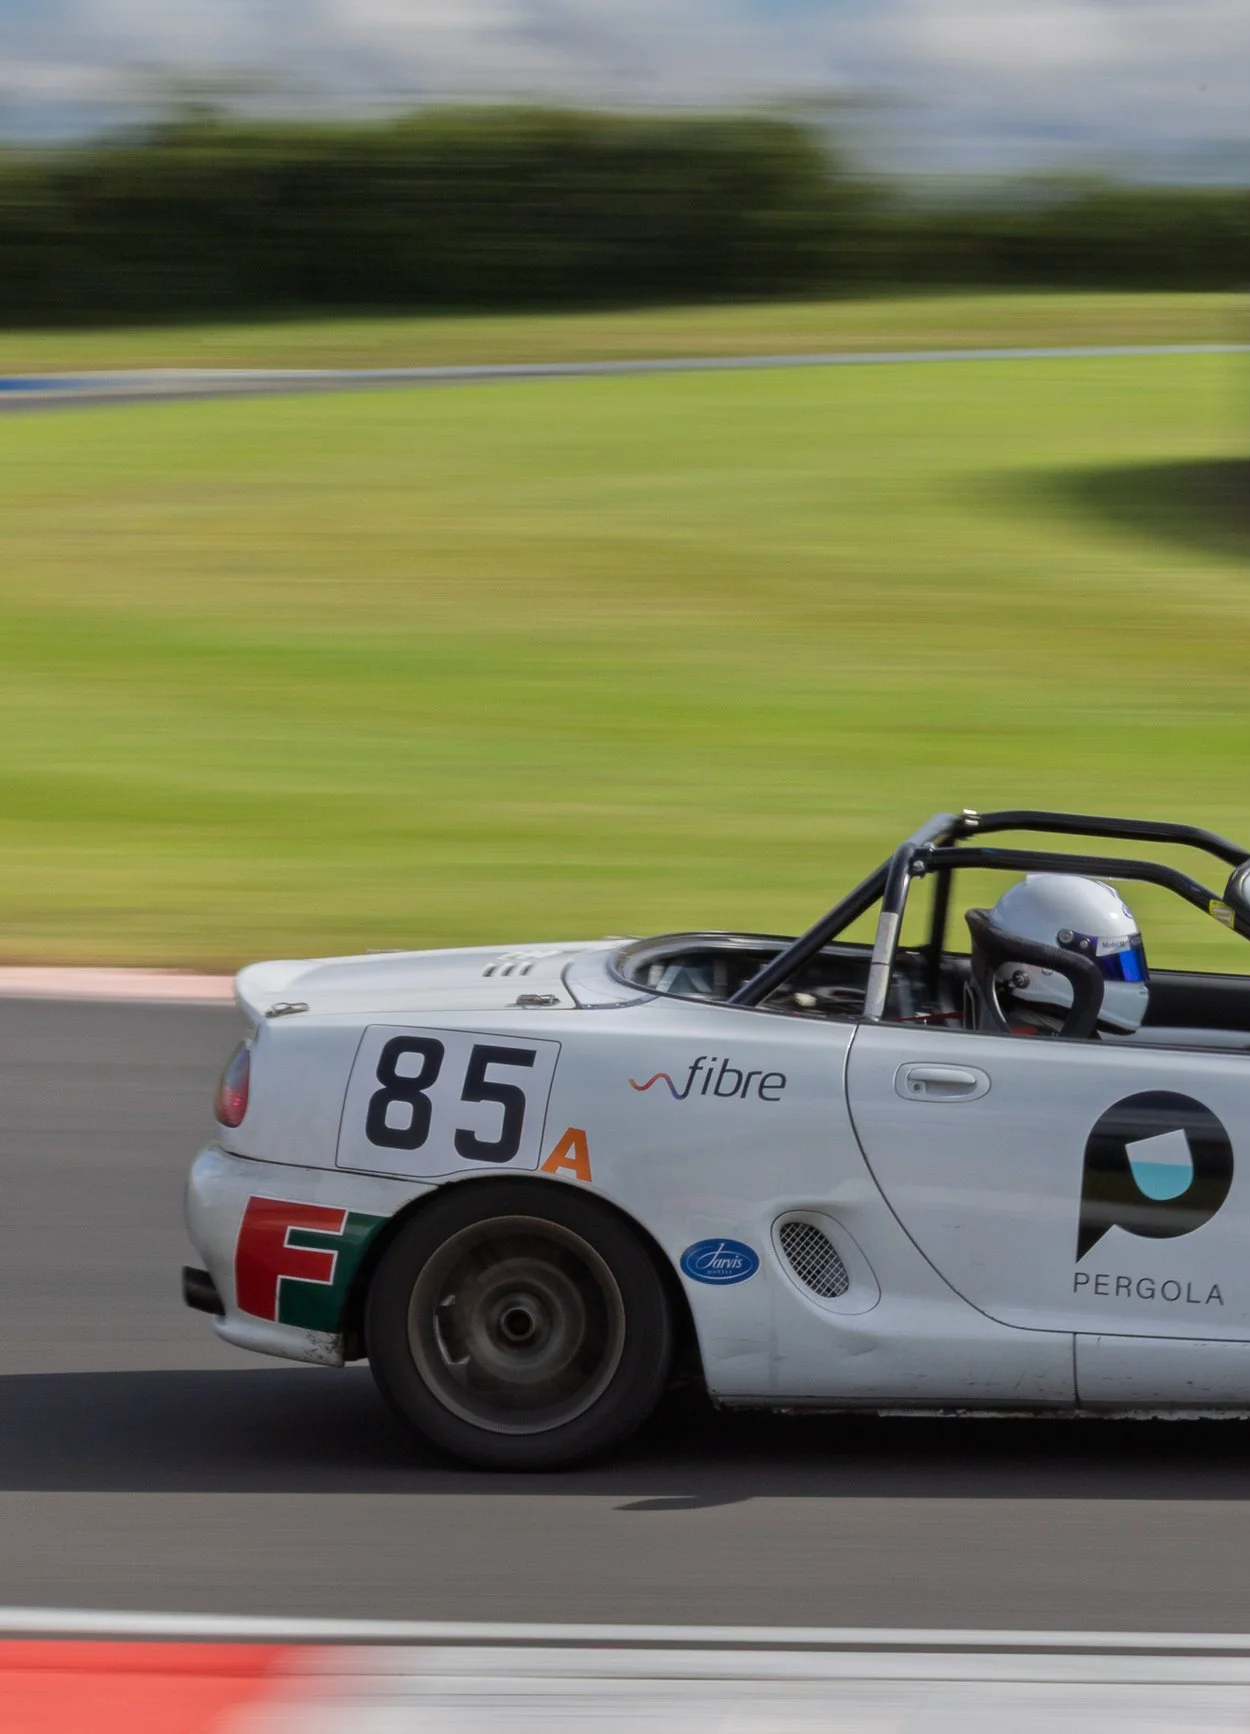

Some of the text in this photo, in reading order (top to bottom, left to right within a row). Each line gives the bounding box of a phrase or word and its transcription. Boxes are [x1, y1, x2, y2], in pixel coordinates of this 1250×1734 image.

[365, 1035, 537, 1163] 85
[680, 1056, 787, 1102] fibre
[540, 1127, 592, 1182] A
[696, 1243, 743, 1270] Jarvis
[1073, 1272, 1225, 1306] PERGOLA
